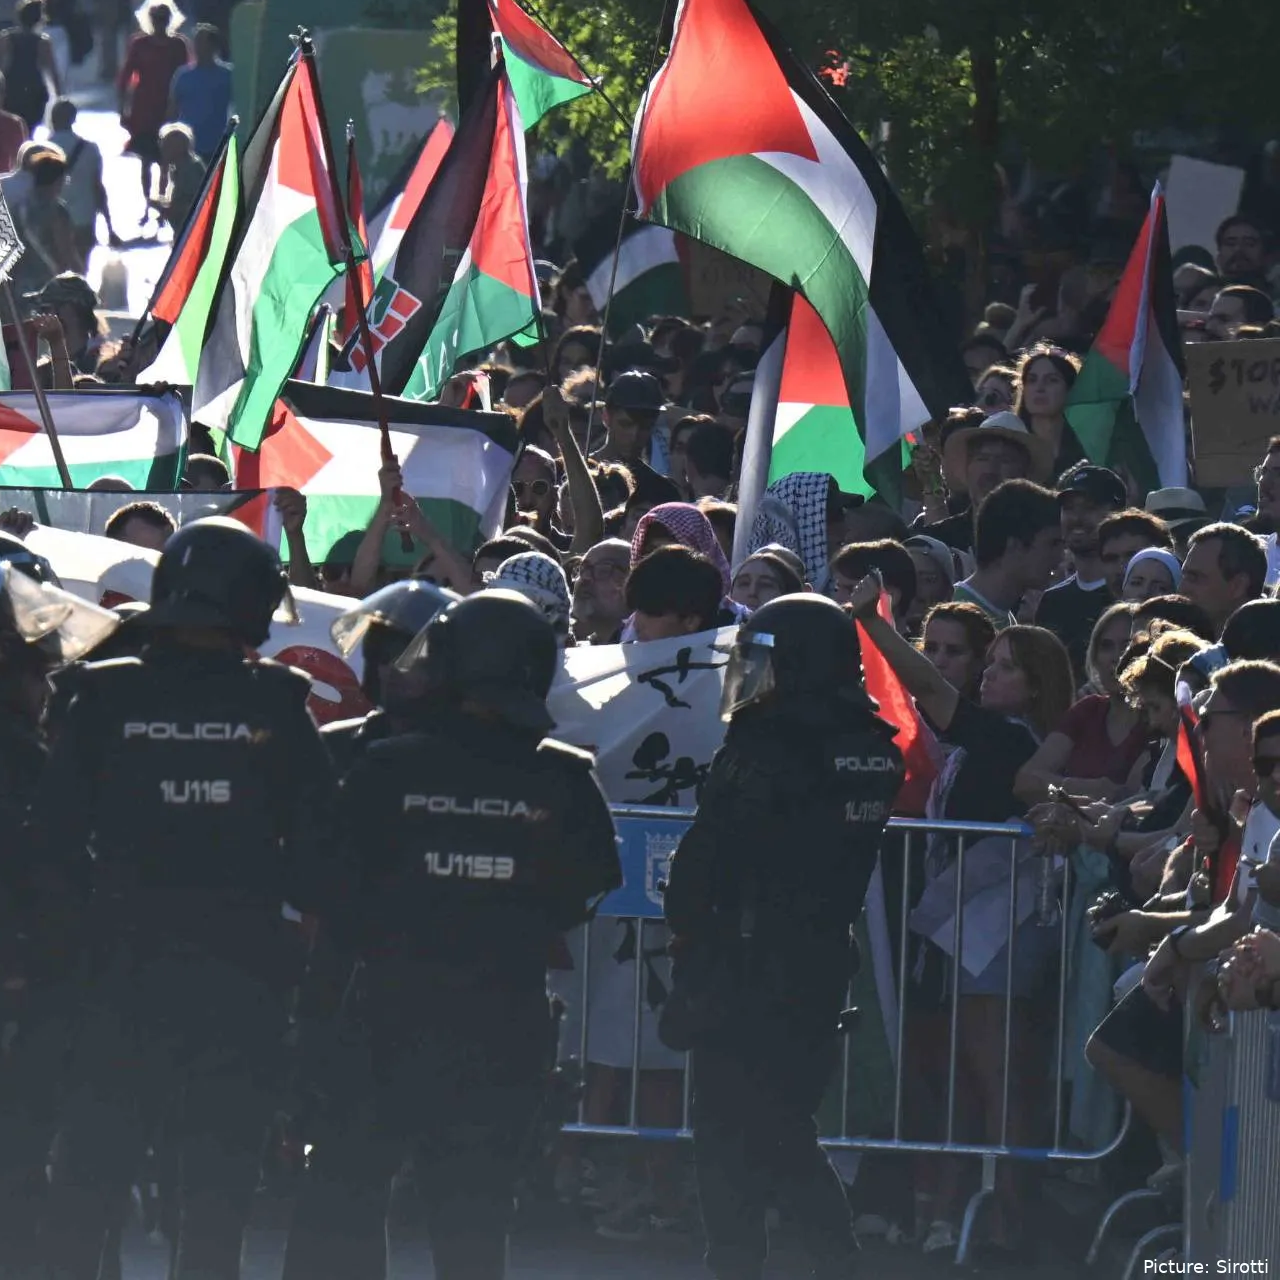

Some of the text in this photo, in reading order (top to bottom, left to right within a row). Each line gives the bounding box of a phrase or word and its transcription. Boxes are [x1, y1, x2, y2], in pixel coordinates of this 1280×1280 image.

[123, 722, 252, 741] POLICIA
[834, 756, 897, 772] POLICIA
[403, 794, 530, 817] POLICIA
